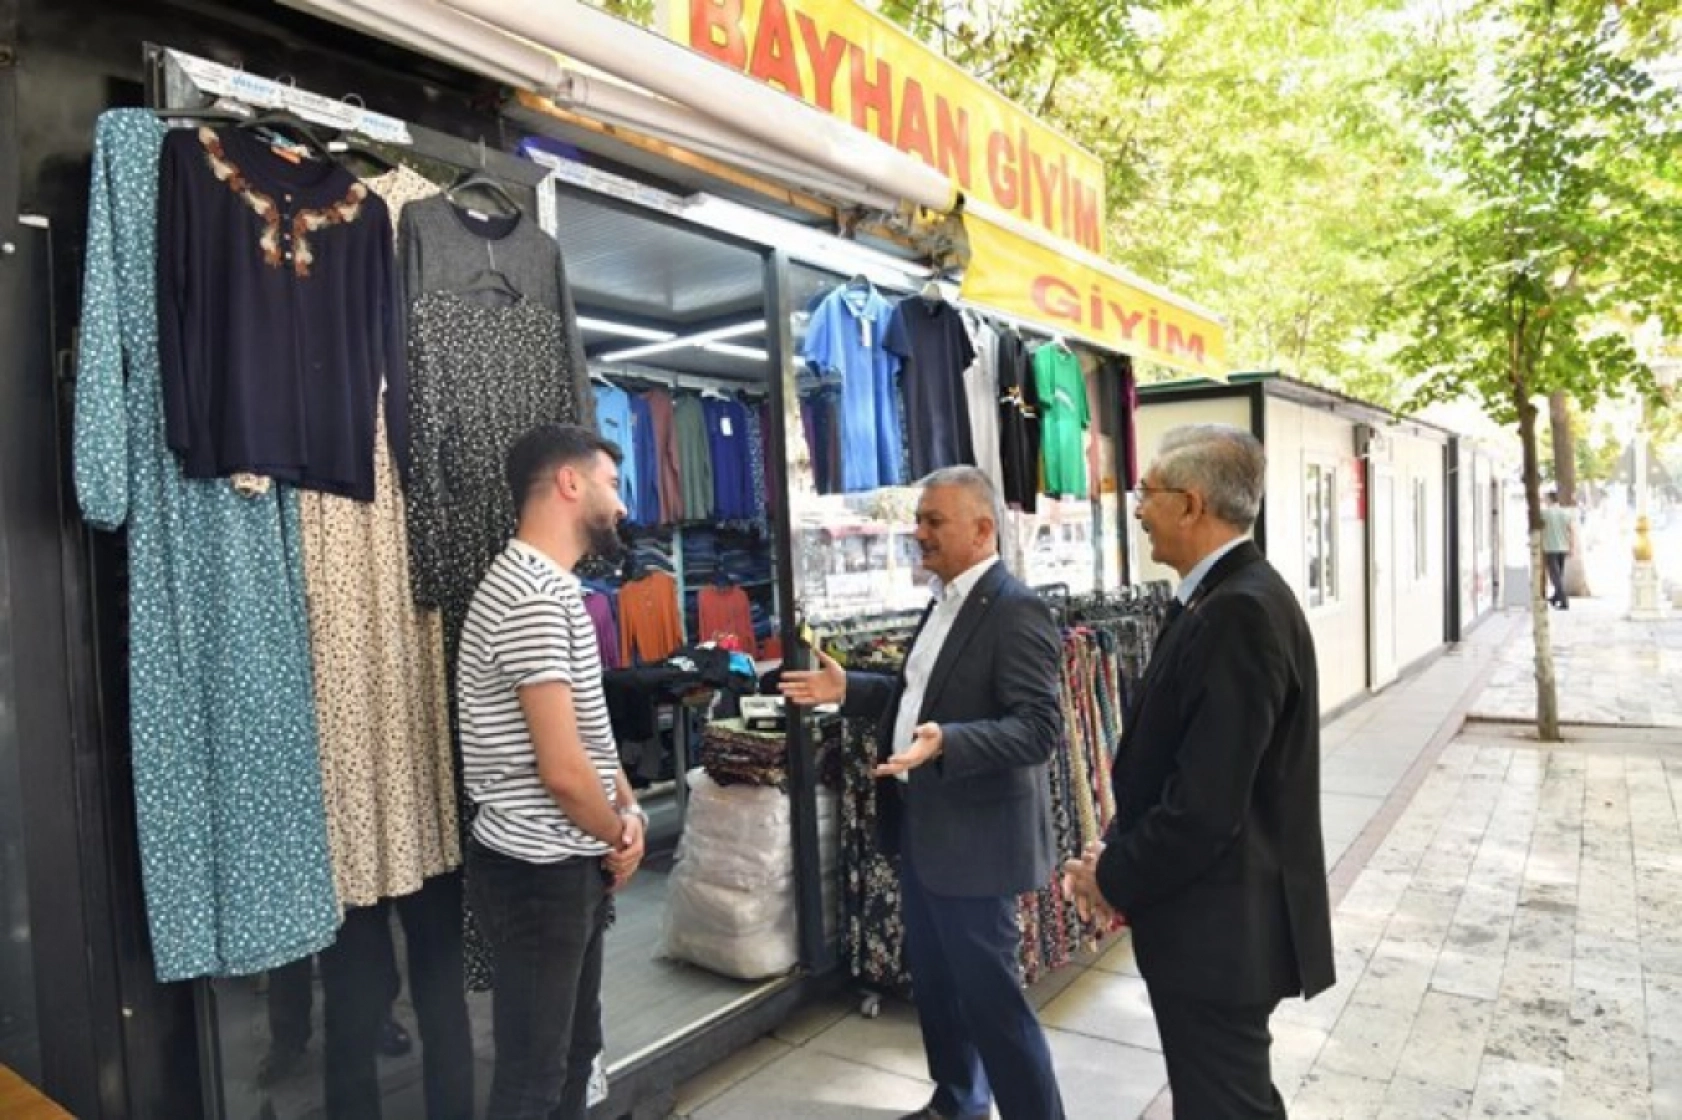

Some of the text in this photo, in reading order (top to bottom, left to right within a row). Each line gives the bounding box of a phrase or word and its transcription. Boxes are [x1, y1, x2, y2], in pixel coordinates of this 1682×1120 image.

[689, 0, 1101, 255] BAYHAN GİYİM
[1031, 274, 1205, 363] GİYİM
